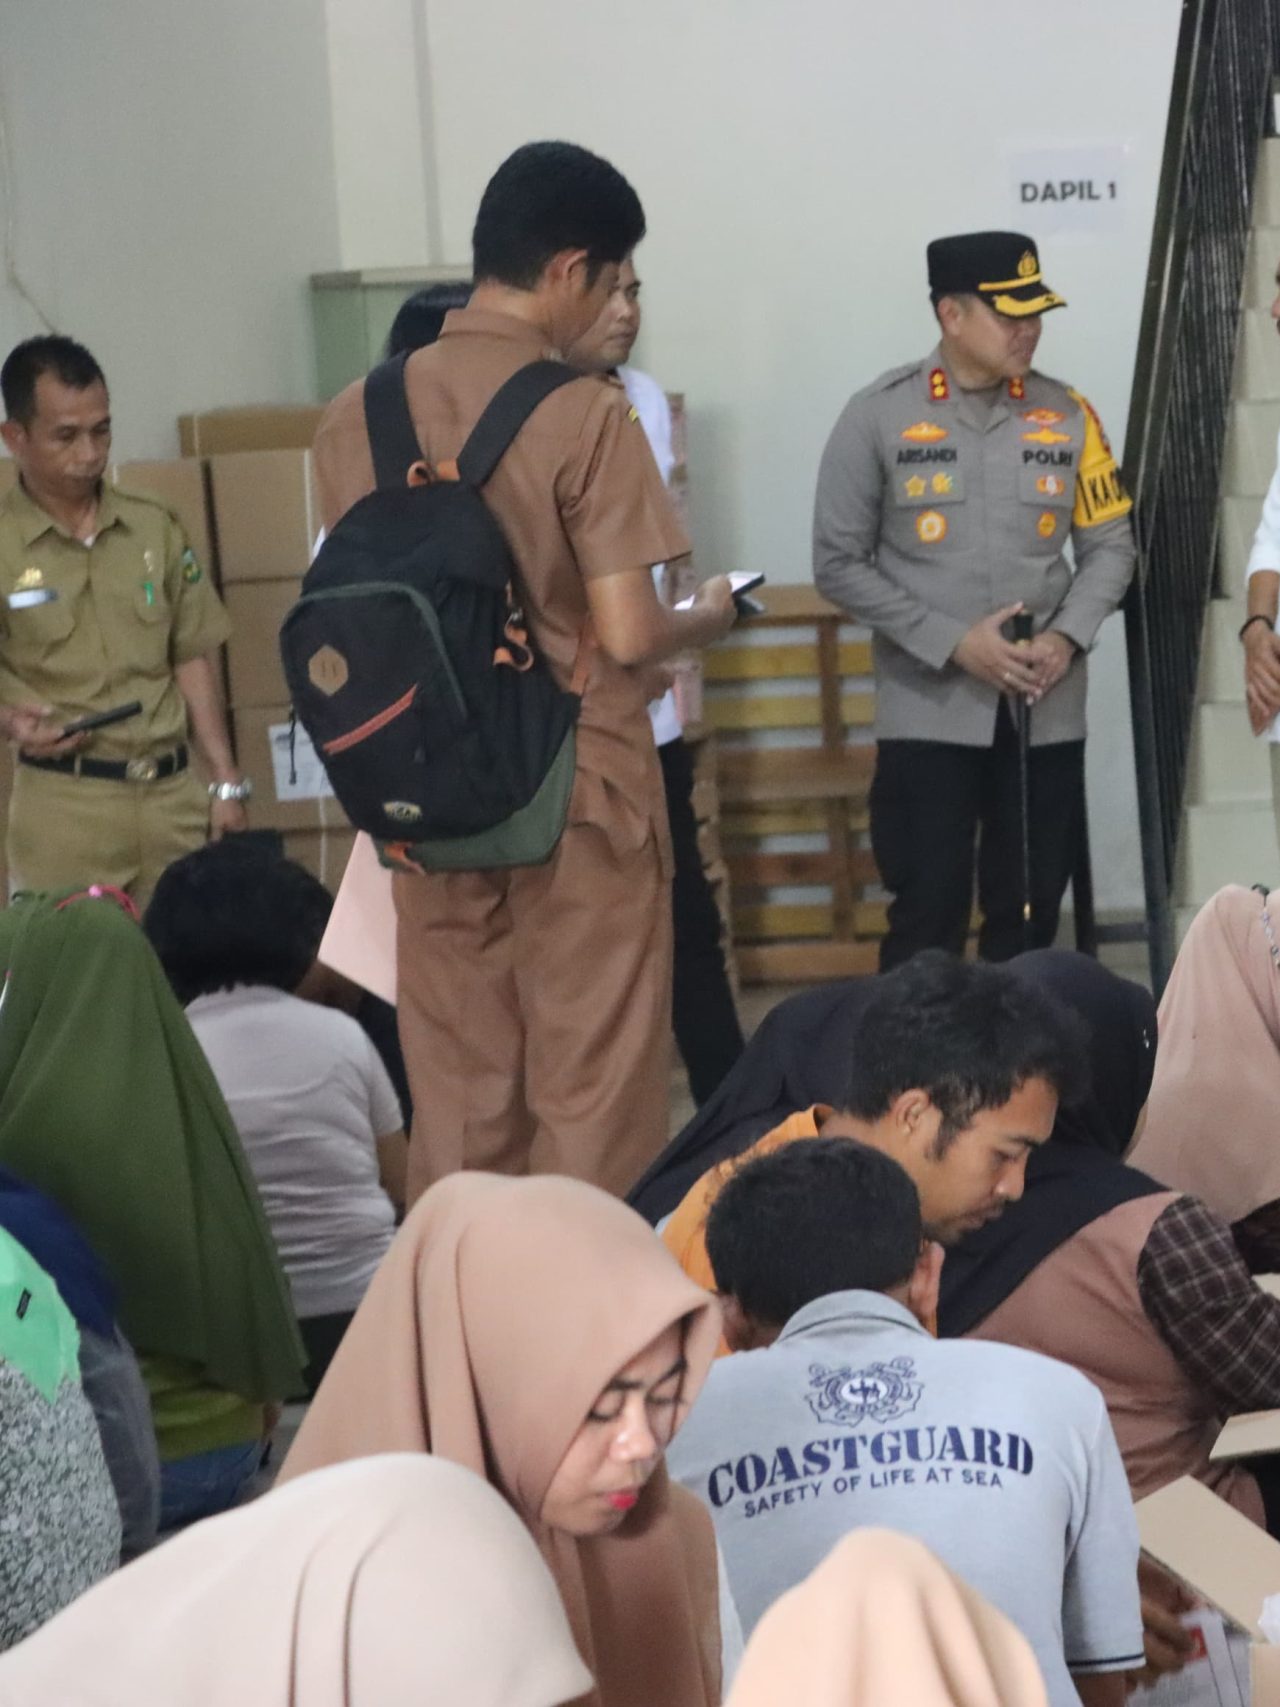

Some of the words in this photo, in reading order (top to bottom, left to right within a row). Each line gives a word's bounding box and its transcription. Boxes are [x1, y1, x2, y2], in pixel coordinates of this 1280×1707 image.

[1020, 180, 1101, 203] DAPIL
[1108, 180, 1117, 199] 1
[1022, 449, 1073, 466] POLRI
[707, 1425, 1034, 1508] COASTGUARD
[744, 1481, 825, 1518] SAFETY
[833, 1475, 862, 1495] OF
[870, 1469, 916, 1489] LIFE
[925, 1467, 955, 1485] AT
[961, 1467, 1003, 1488] SEA
